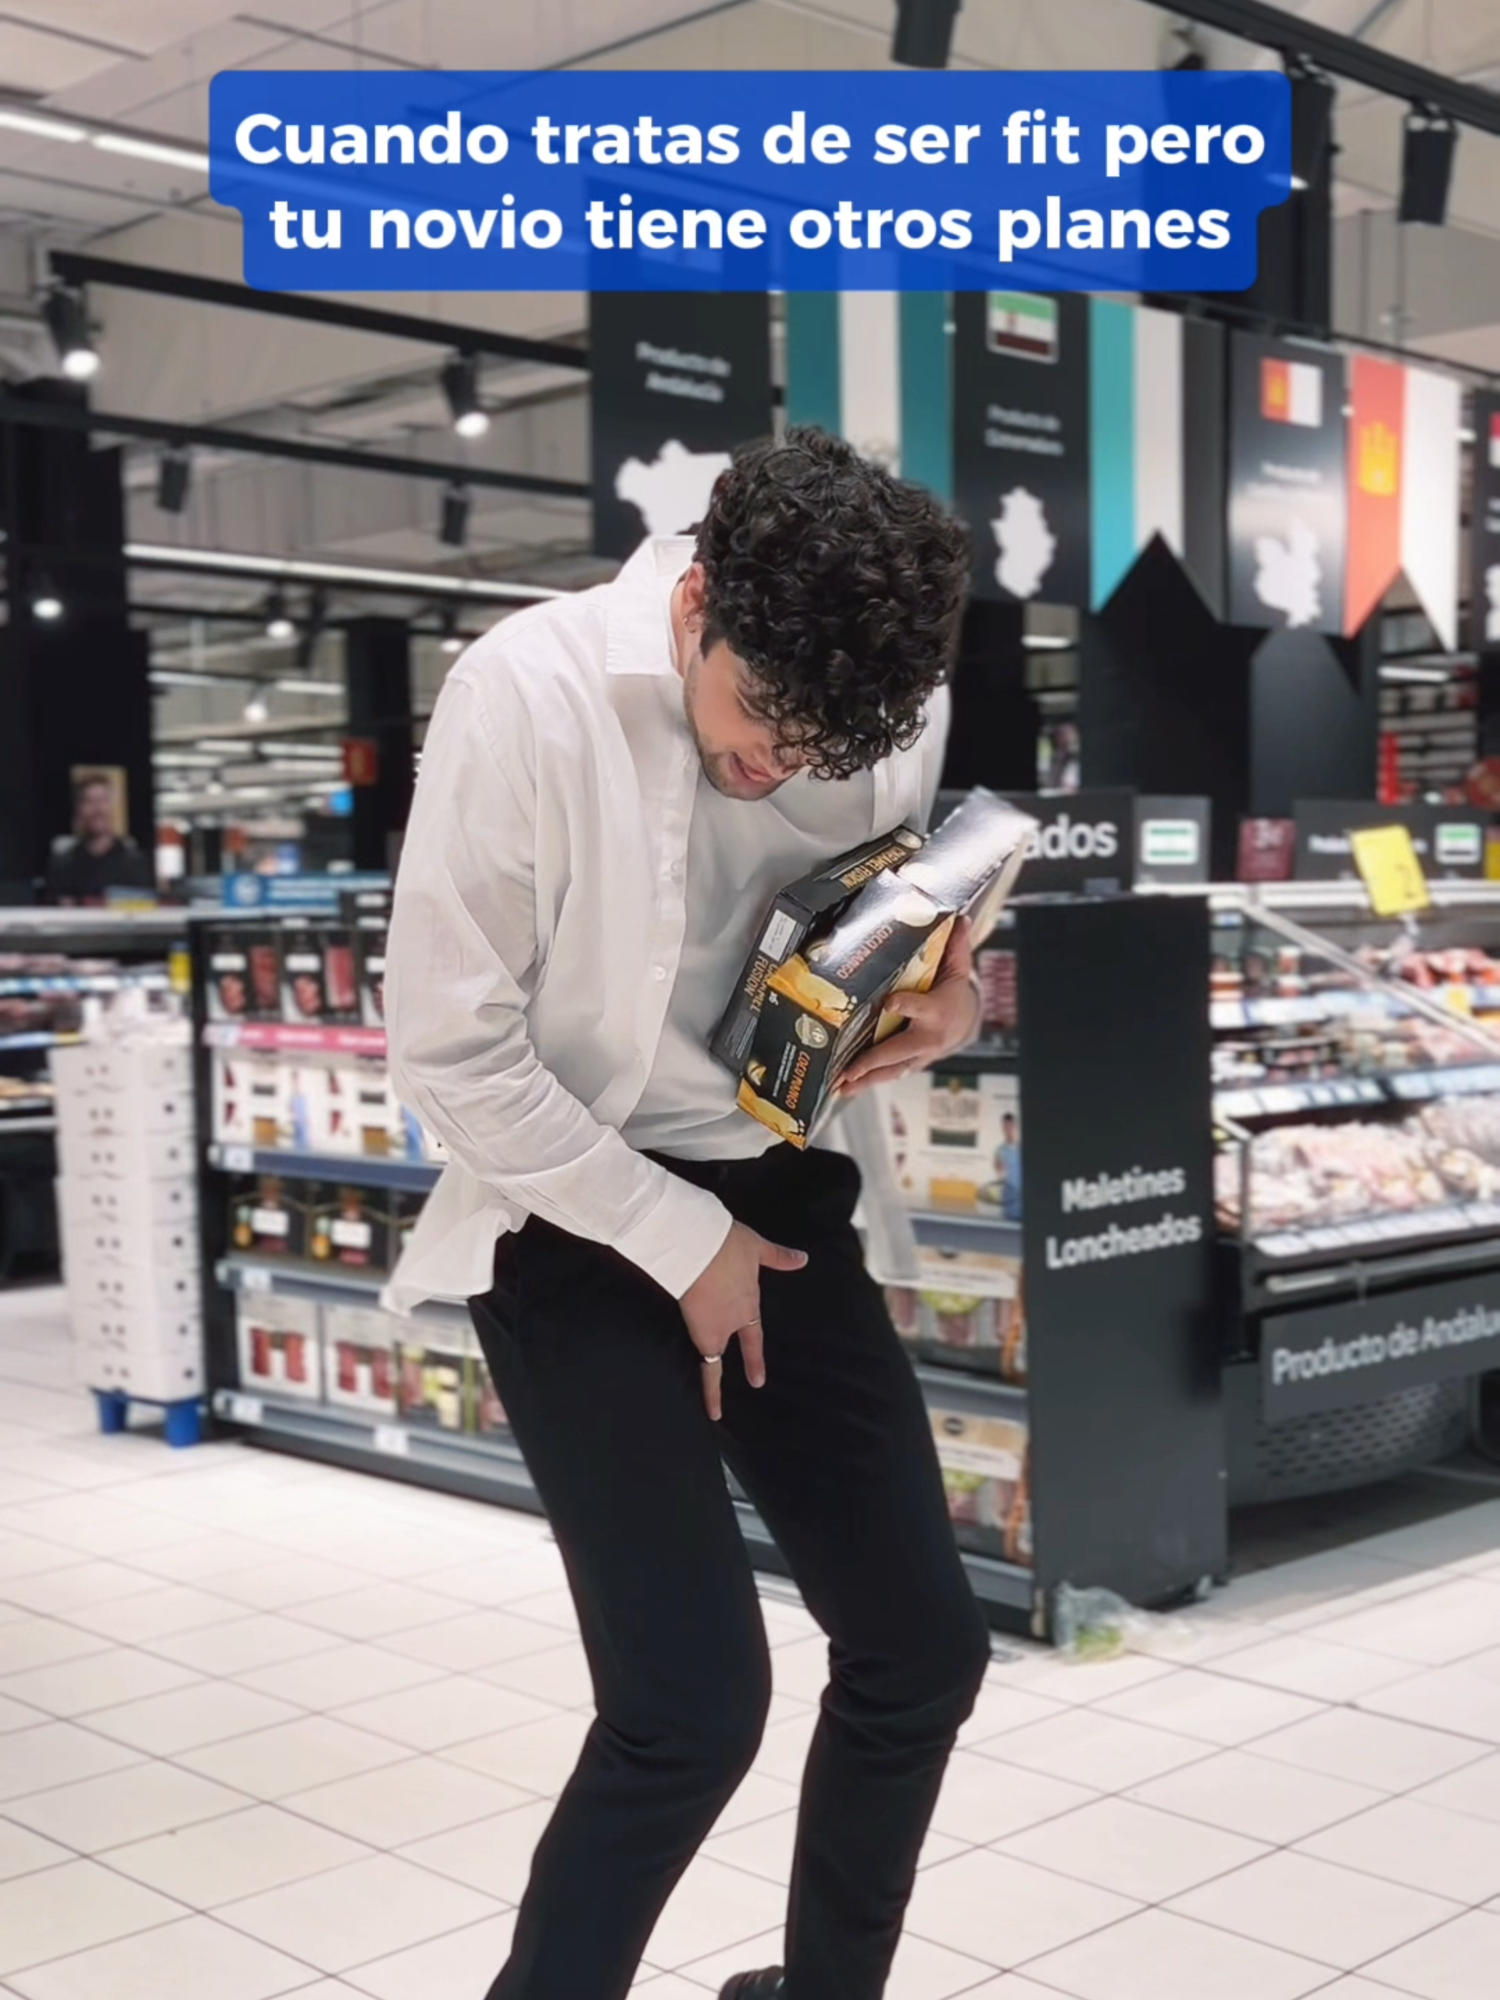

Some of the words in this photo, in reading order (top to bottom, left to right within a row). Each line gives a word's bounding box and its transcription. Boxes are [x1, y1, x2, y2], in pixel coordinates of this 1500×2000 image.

[1022, 813, 1118, 860] ados
[865, 924, 893, 950] COCO
[743, 954, 768, 997] FUSION
[836, 944, 871, 980] MANGO
[793, 1050, 811, 1078] COCO
[785, 1074, 804, 1110] MANGO
[1061, 1165, 1187, 1213] Maletines
[1046, 1212, 1202, 1270] Loncheados
[1272, 1333, 1385, 1385] Producto
[1387, 1321, 1419, 1359] de
[1420, 1303, 1500, 1352] Andalu
